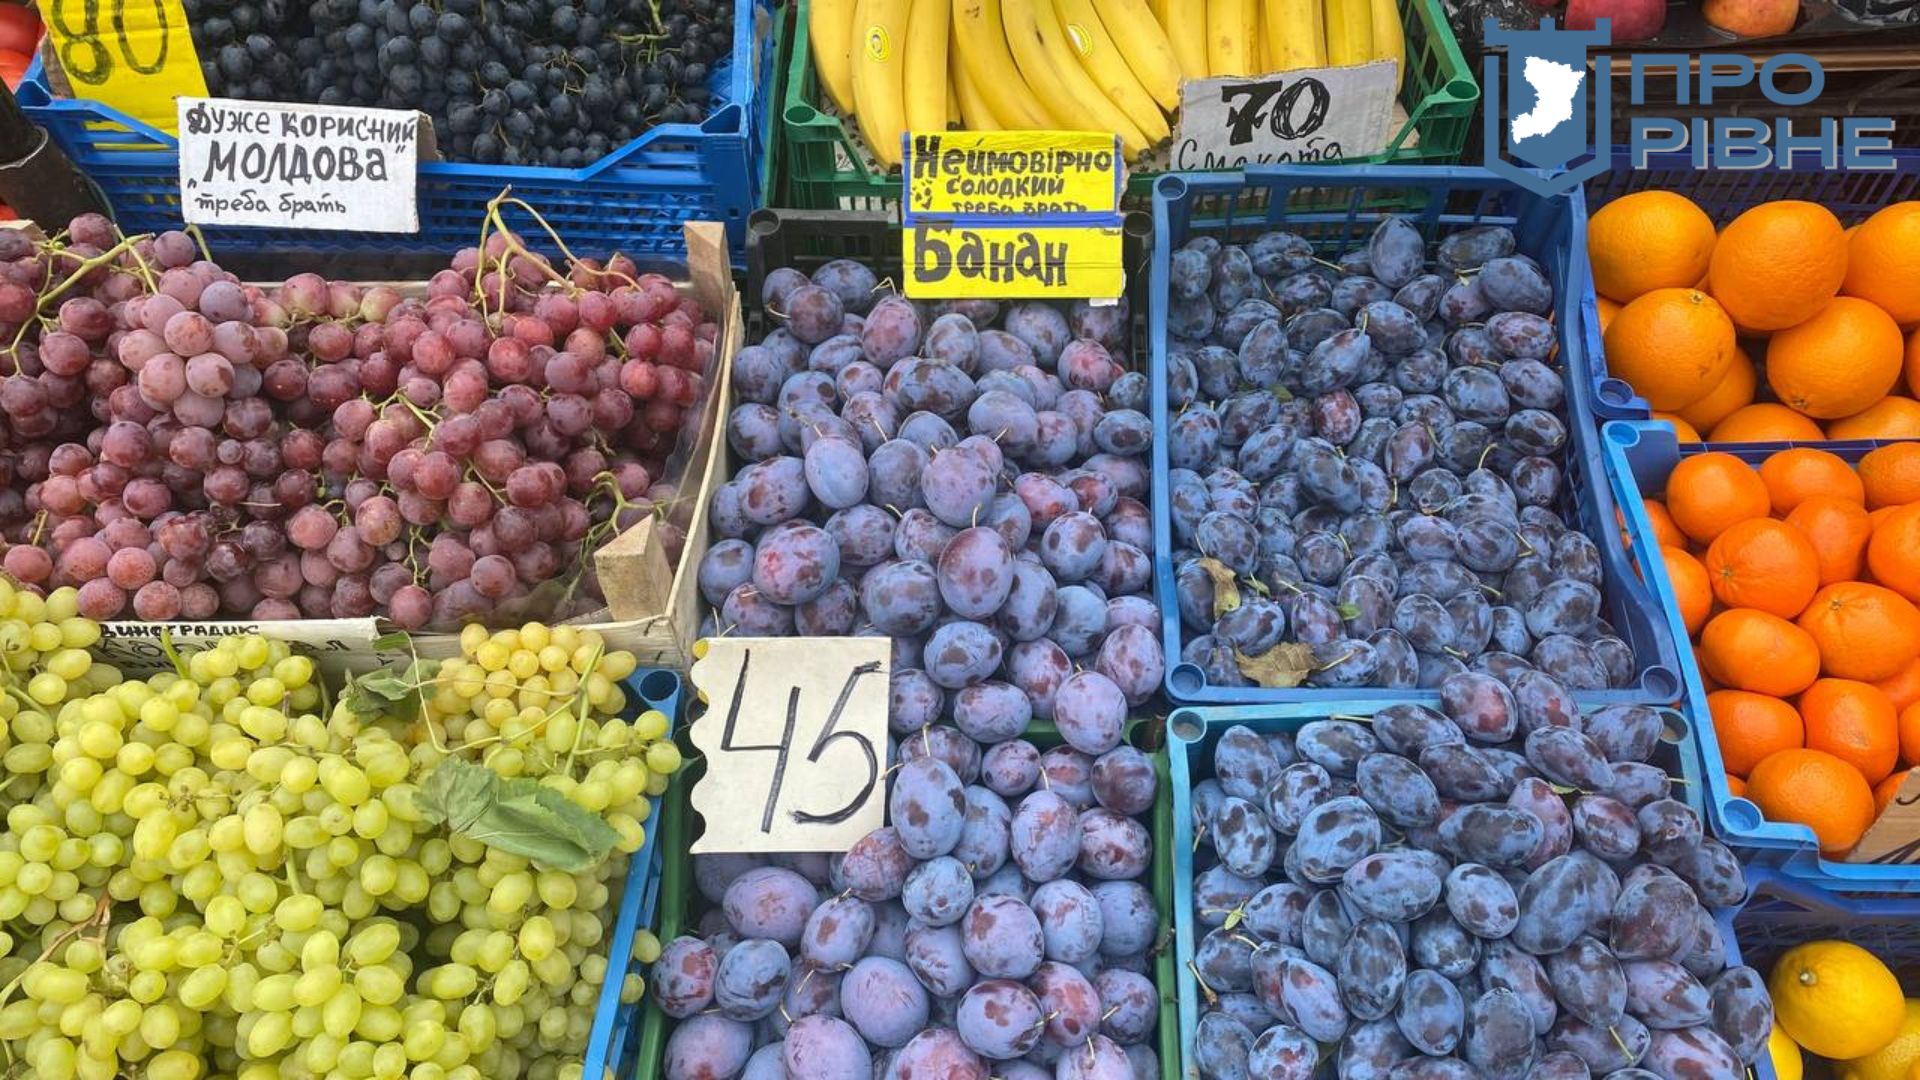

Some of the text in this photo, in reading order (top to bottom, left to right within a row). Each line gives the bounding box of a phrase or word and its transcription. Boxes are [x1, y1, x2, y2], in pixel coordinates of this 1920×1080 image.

[1221, 77, 1331, 146] 70
[914, 135, 1113, 179] Неймовірно
[194, 189, 346, 219] треба брать
[914, 219, 1069, 287] Банан
[720, 648, 888, 835] 45
